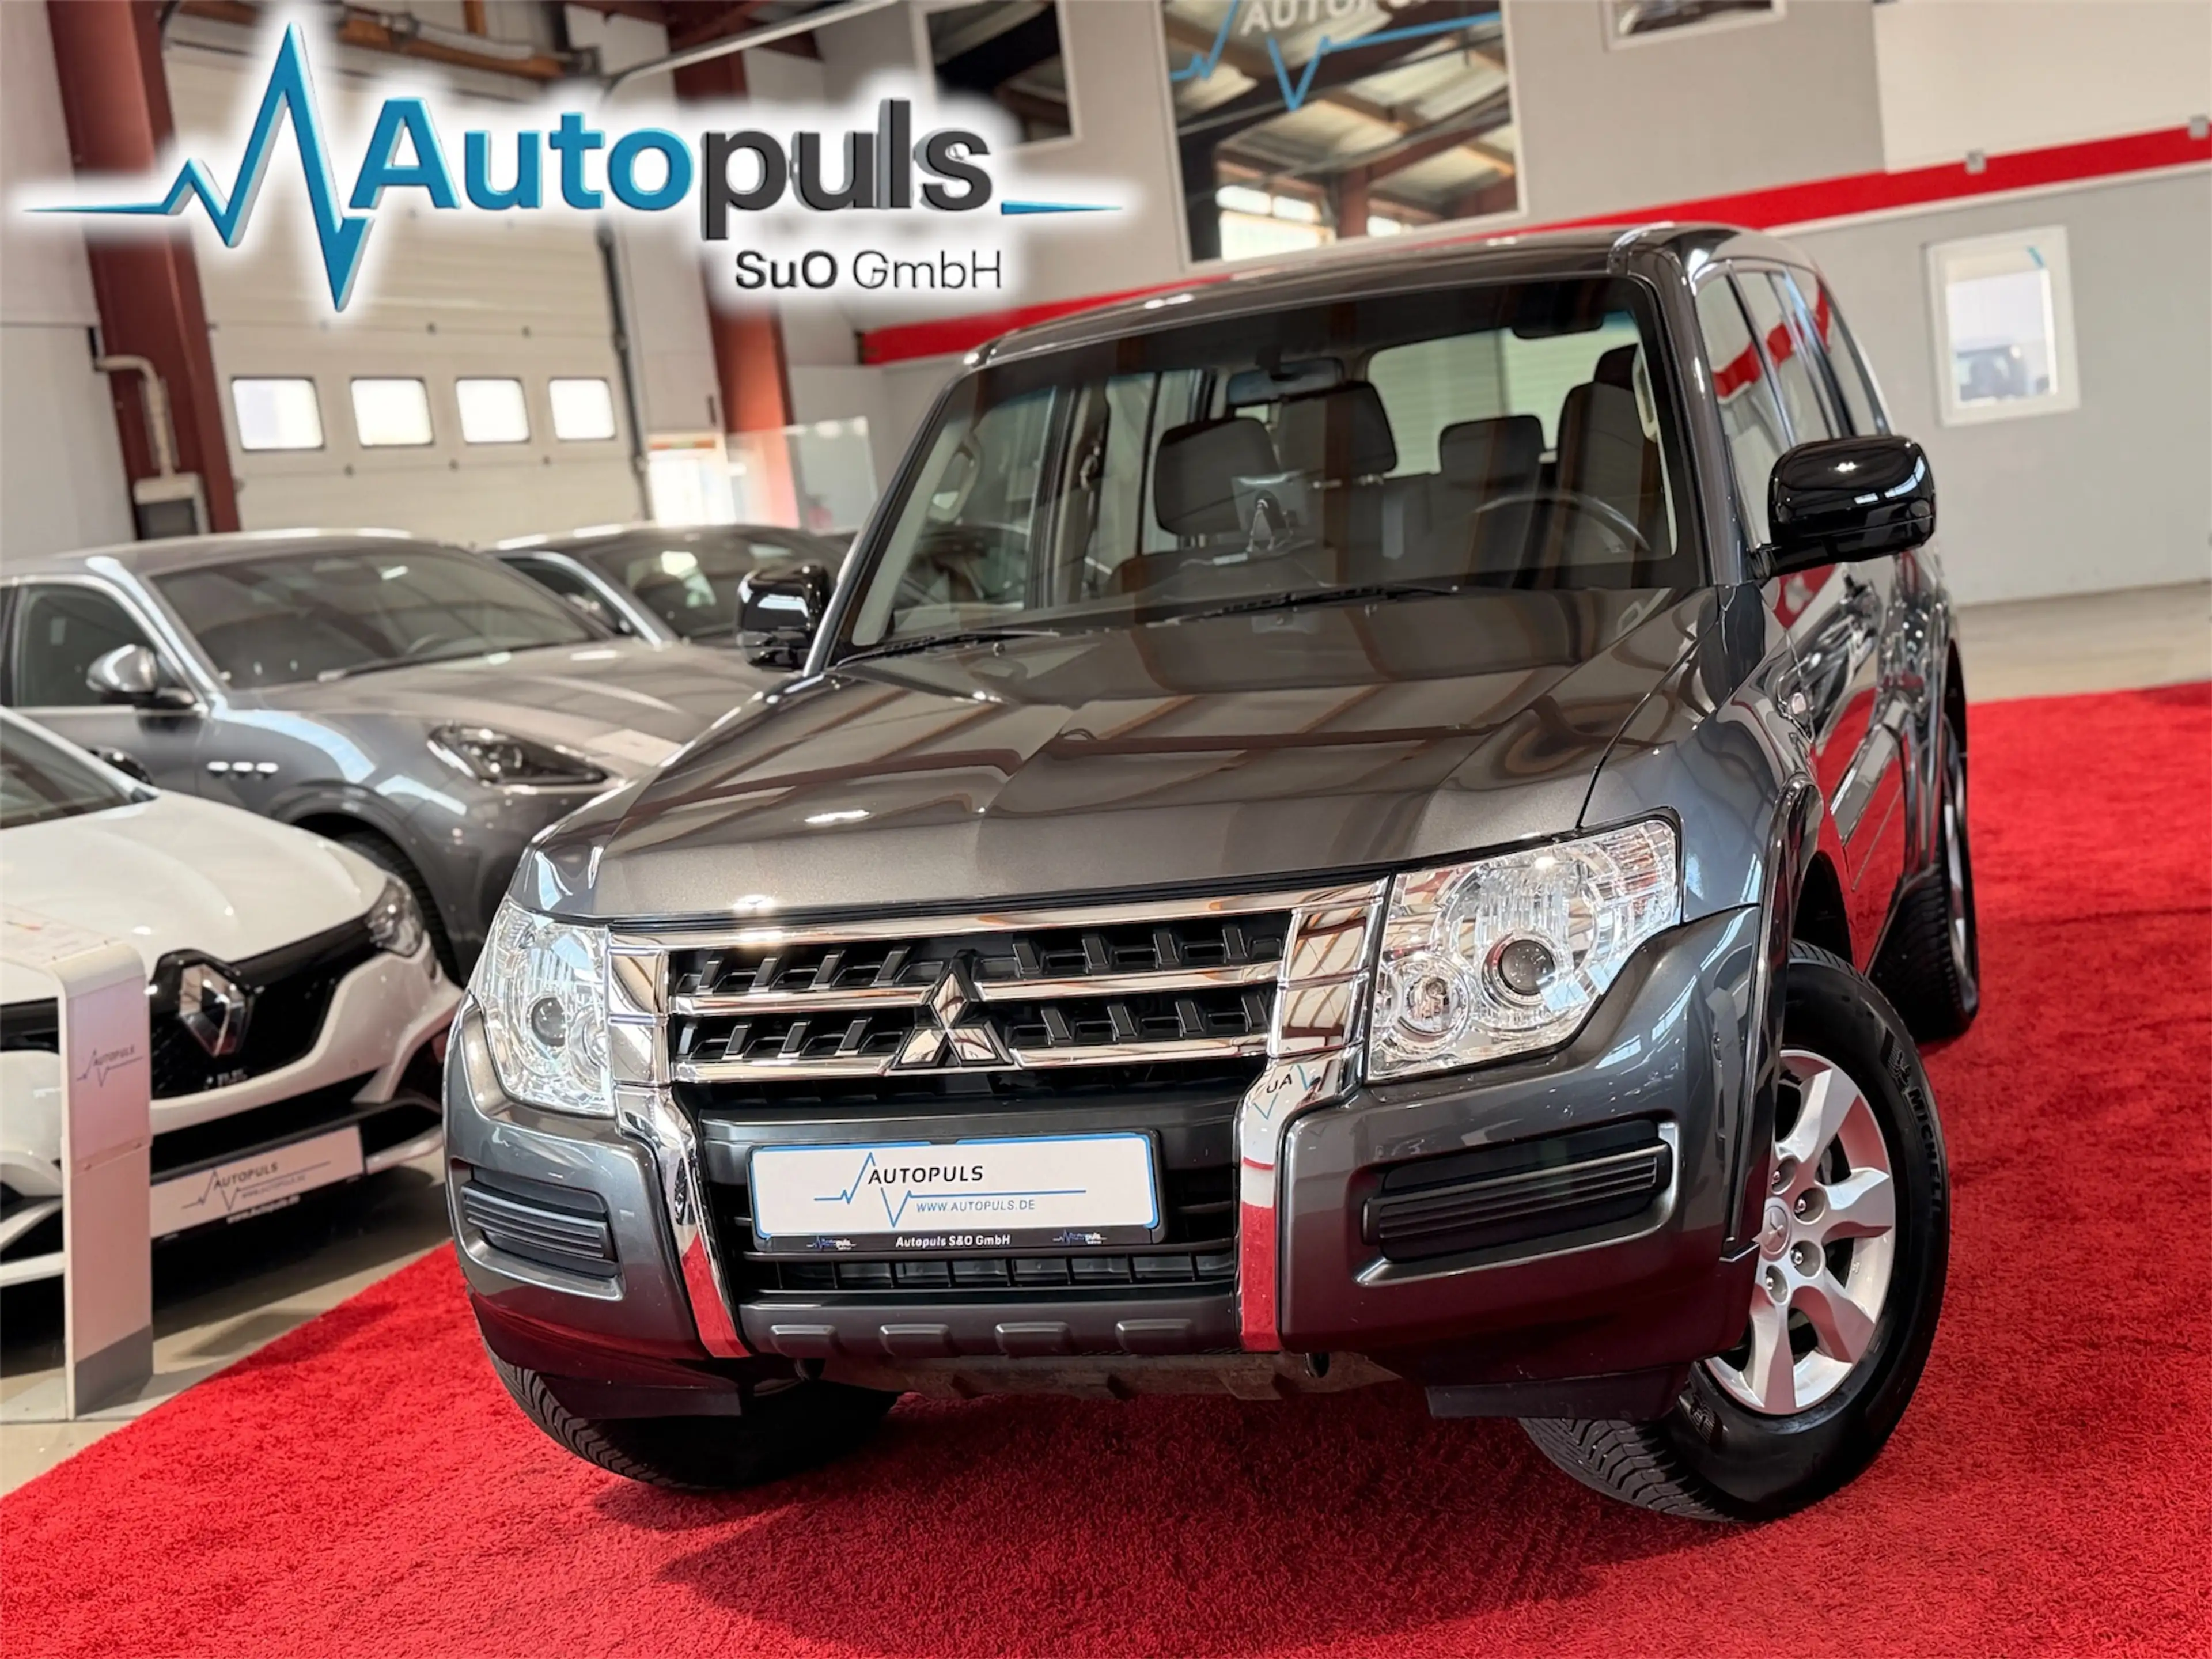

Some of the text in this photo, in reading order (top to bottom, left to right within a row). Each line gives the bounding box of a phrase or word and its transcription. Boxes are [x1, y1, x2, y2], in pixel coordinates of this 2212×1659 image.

[1907, 1086, 1942, 1219] MICHELI
[214, 1161, 279, 1191] AUTOPULS
[868, 1165, 984, 1185] AUTOPULS
[916, 1199, 1036, 1213] WWW.AUTOPULS.DE
[895, 1234, 1011, 1248] Autopuls S&O GmbH
